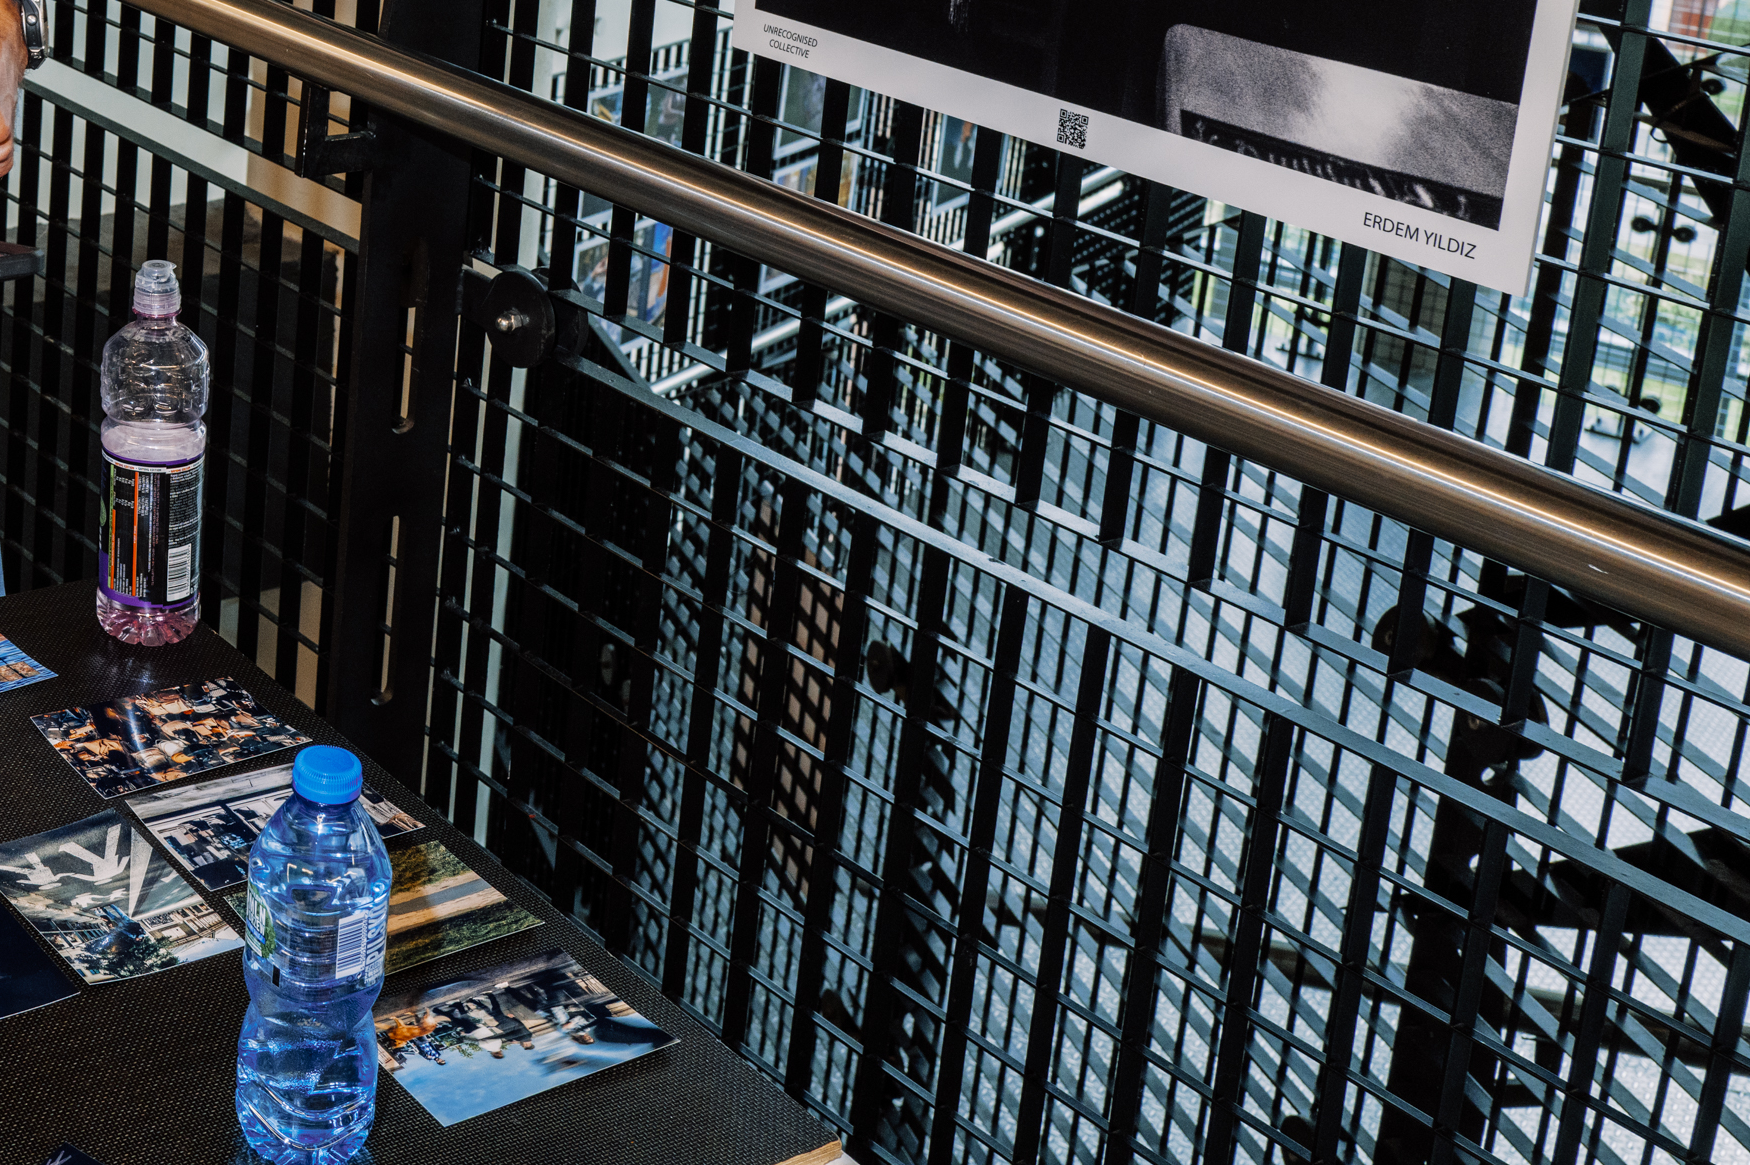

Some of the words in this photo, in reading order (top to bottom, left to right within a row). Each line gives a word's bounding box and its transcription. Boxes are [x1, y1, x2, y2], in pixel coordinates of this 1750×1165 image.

[763, 23, 818, 48] UNRECOGNISED
[769, 38, 810, 59] COLLECTIVE
[1363, 211, 1420, 242] ERDEM
[1423, 229, 1477, 260] YILDIZ
